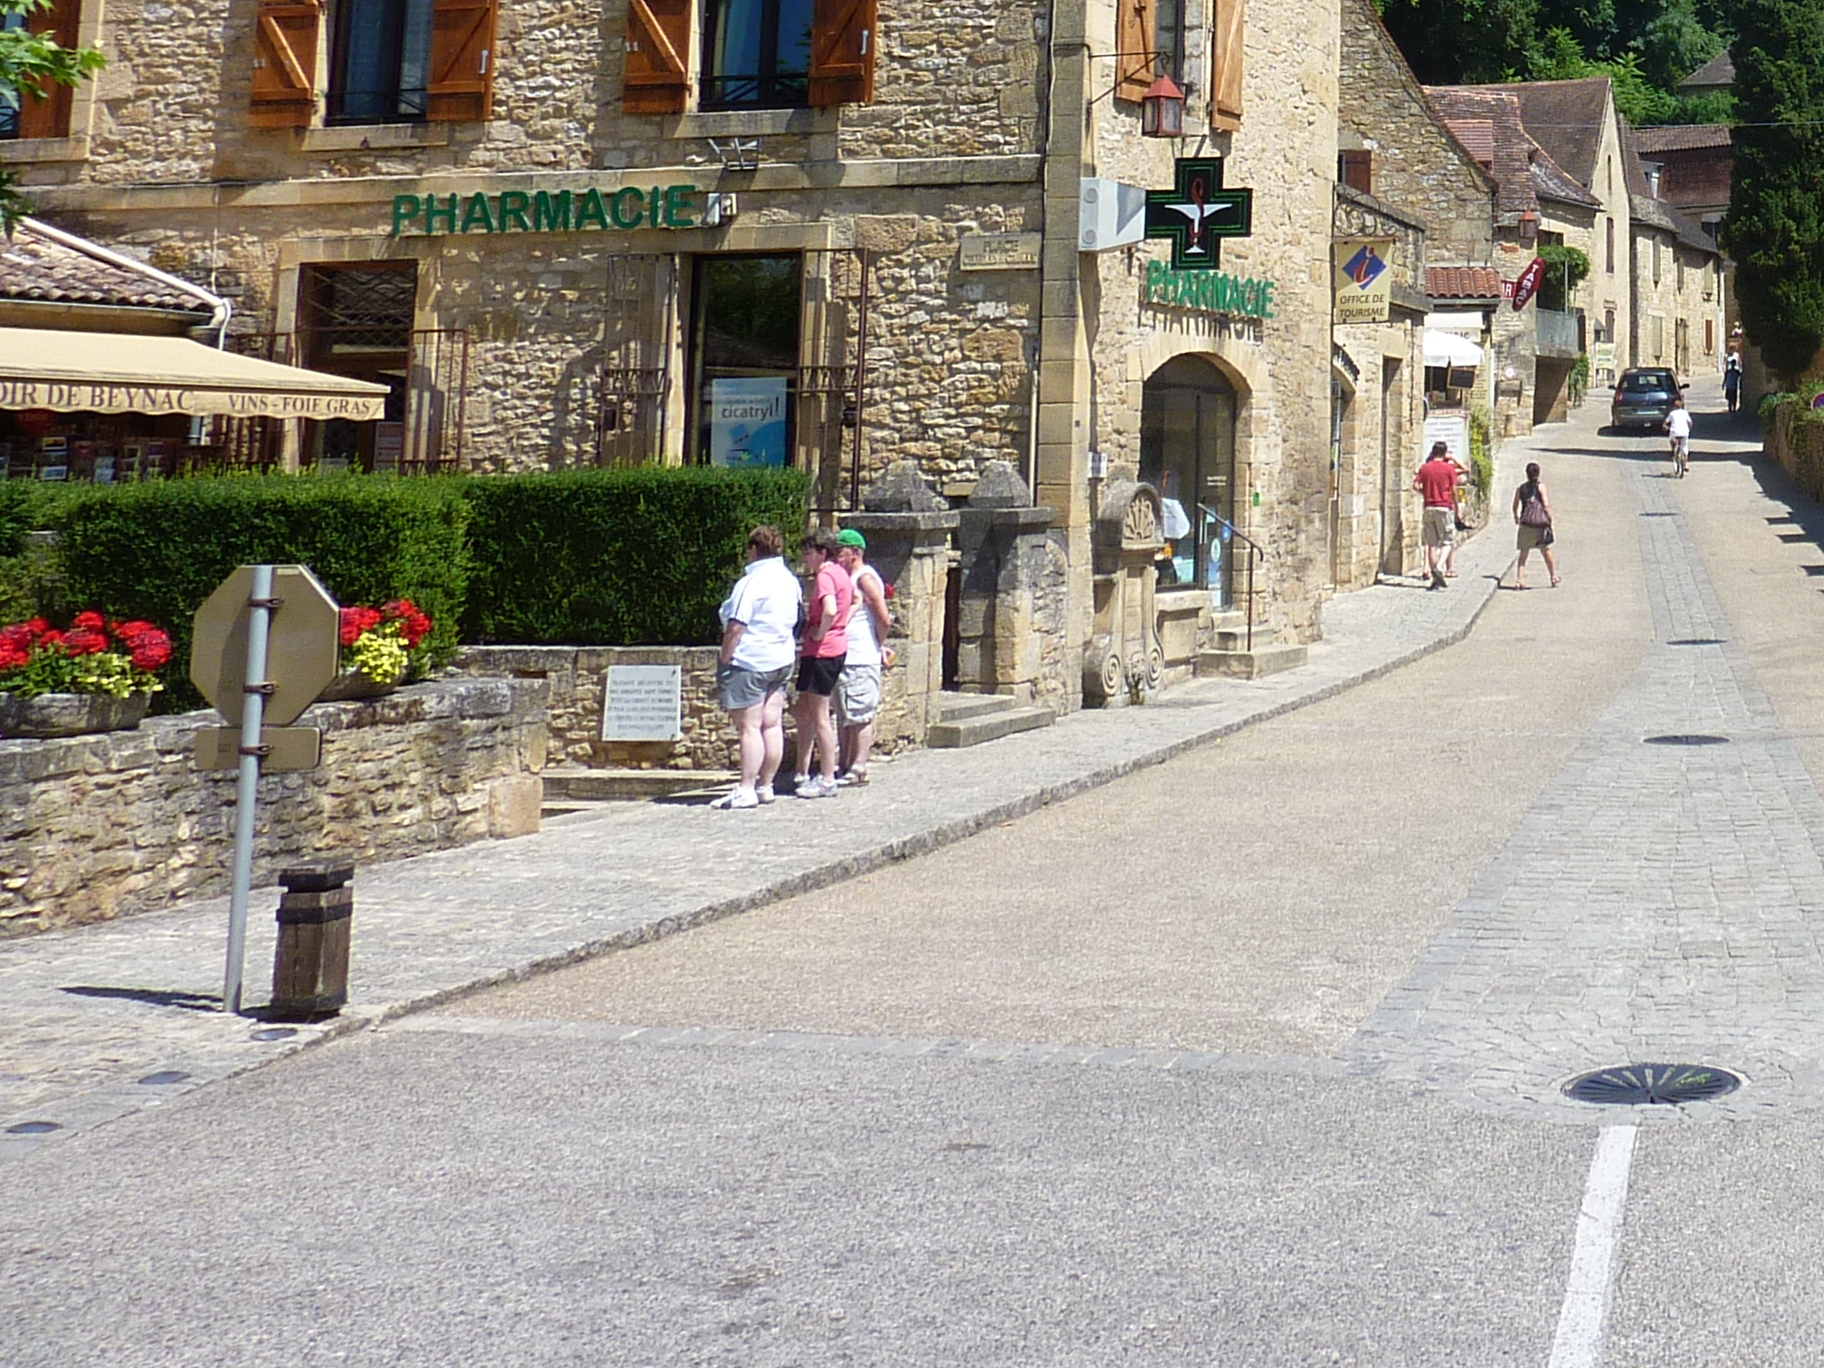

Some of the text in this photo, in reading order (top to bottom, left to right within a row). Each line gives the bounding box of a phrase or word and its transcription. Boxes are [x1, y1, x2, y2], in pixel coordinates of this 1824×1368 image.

[392, 185, 697, 236] PHARMACIE
[1147, 259, 1275, 320] PHARMACIE
[1515, 264, 1539, 305] TABAC
[1339, 307, 1385, 318] TOURISME
[1340, 294, 1385, 305] OFFICE DE
[47, 384, 81, 407] DE
[90, 386, 193, 410] BEYNAC
[228, 395, 268, 411] VINS
[283, 396, 319, 413] FOIE
[327, 399, 371, 414] GRAS
